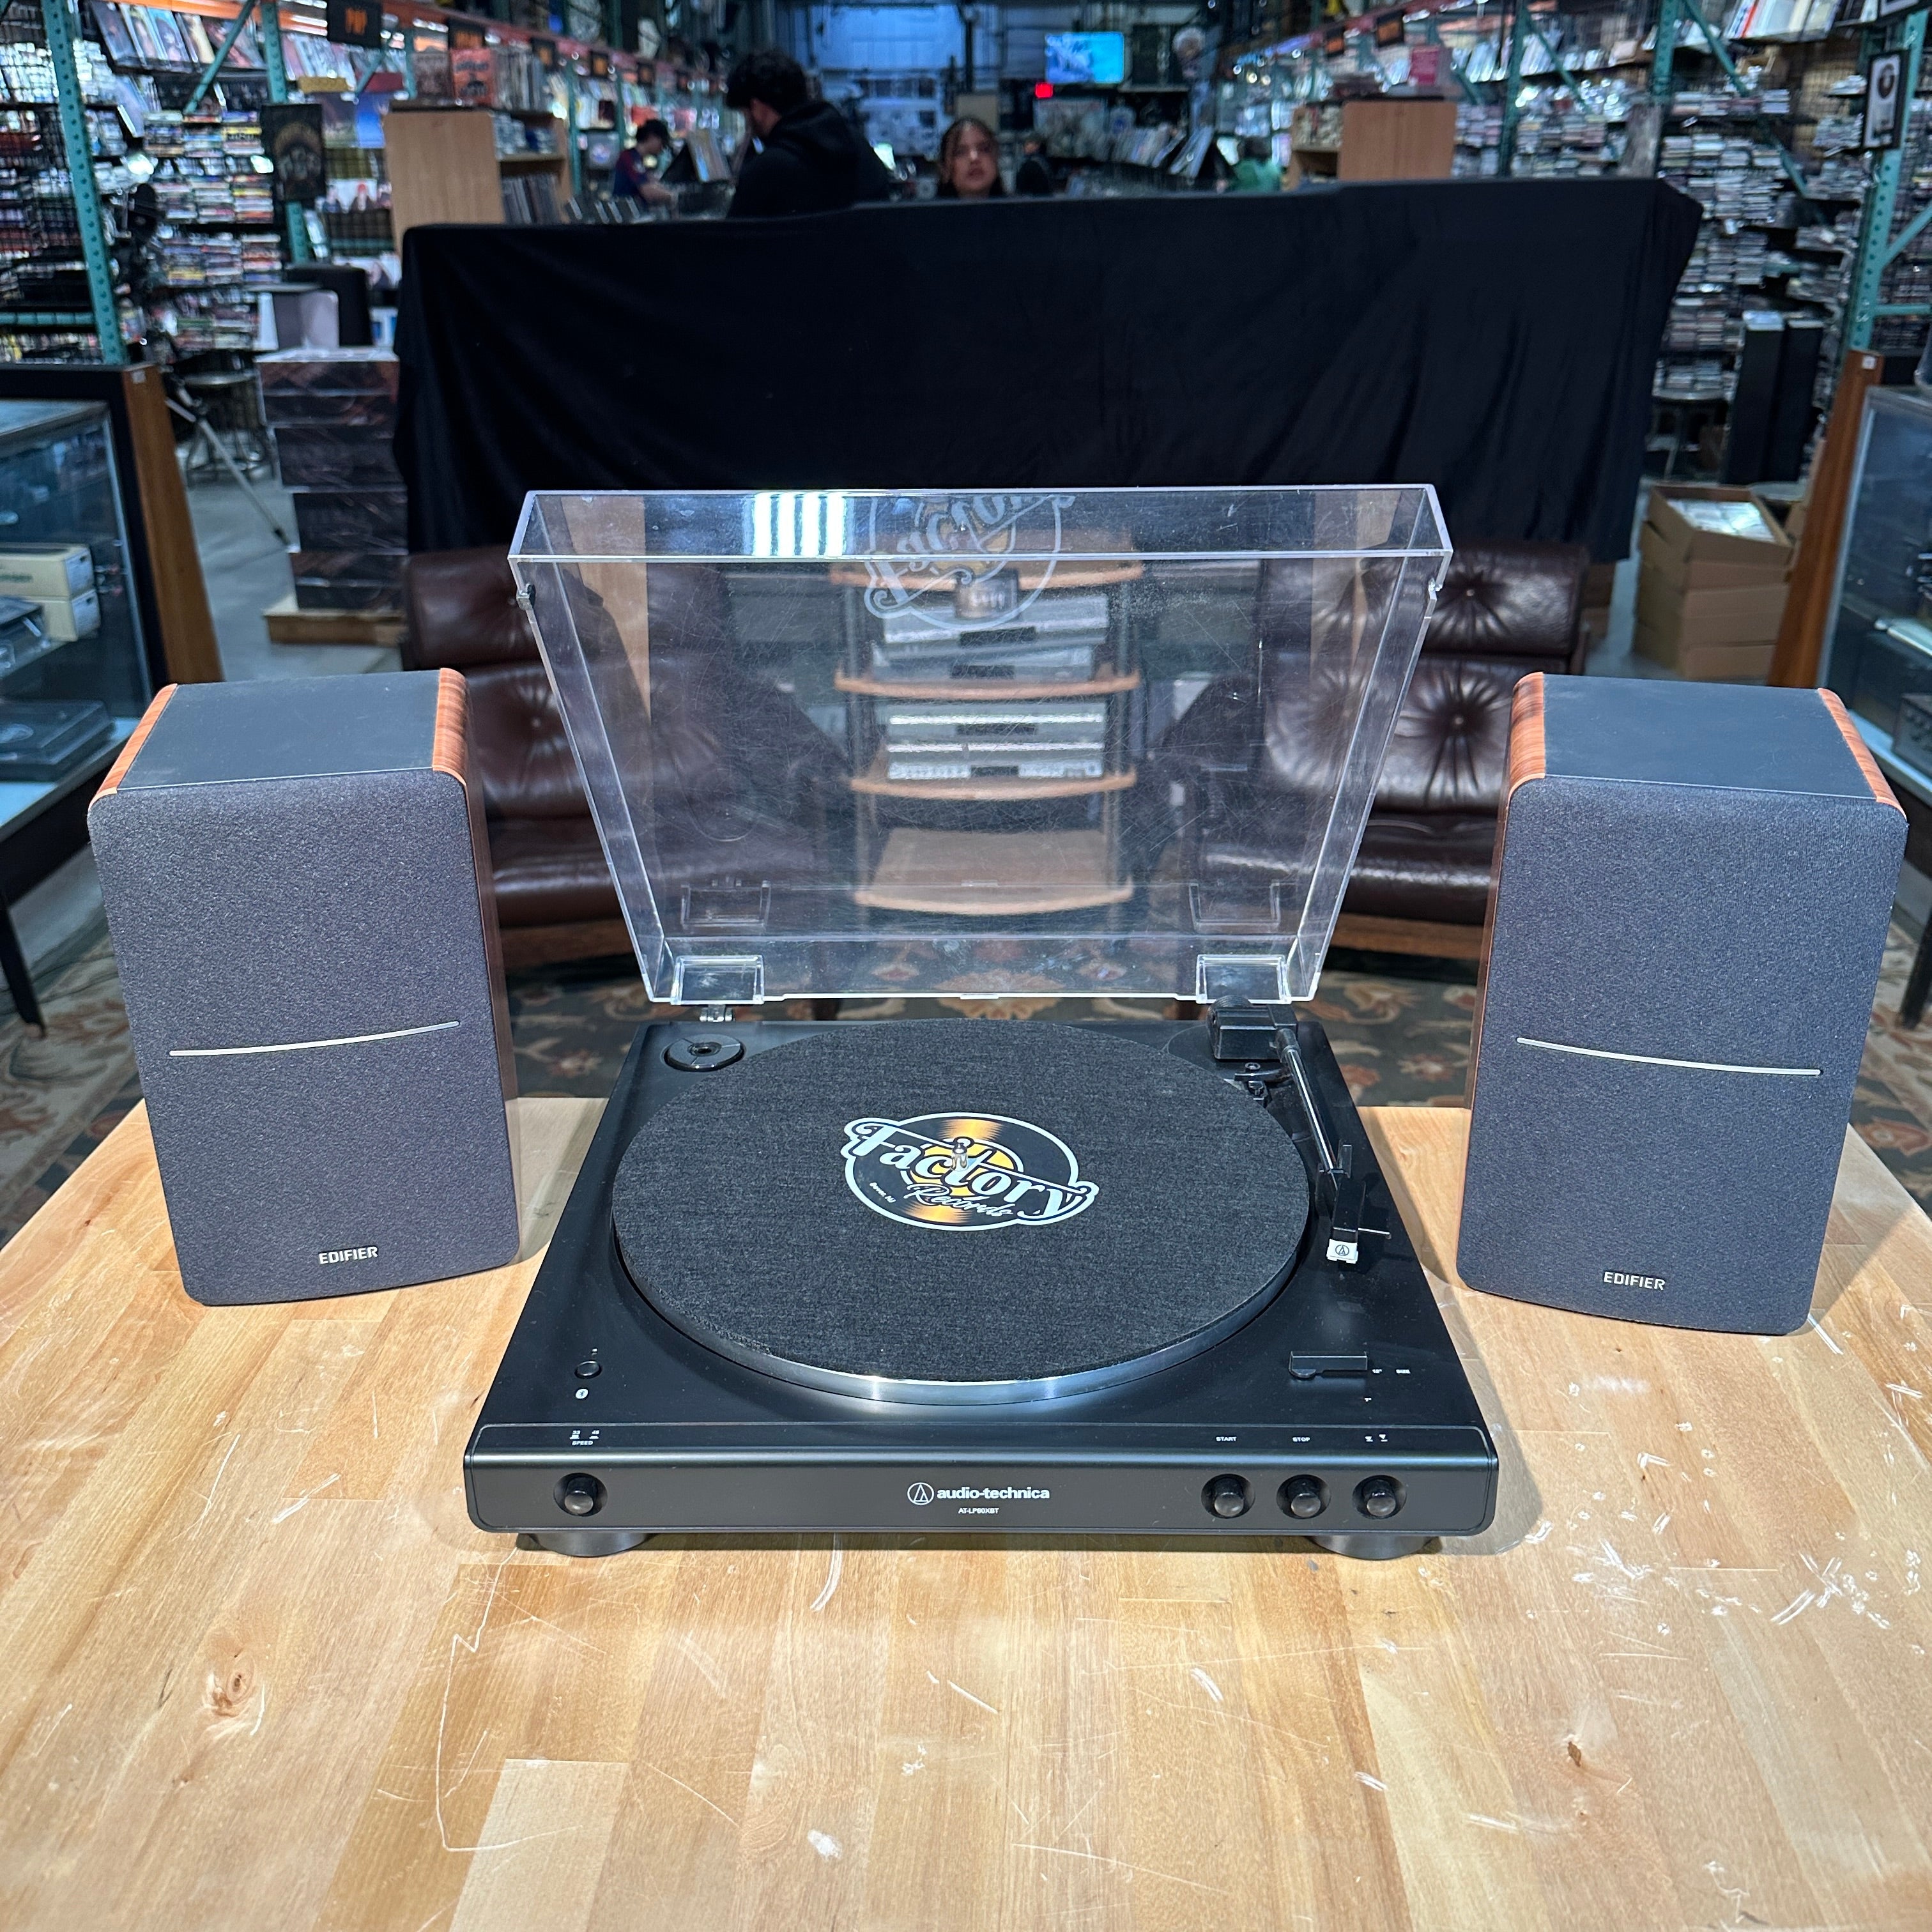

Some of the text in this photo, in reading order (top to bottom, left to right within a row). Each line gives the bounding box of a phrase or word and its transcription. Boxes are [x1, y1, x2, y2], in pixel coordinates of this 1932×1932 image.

[851, 1123, 1089, 1218] Factory
[903, 1183, 1016, 1217] Records
[319, 1246, 378, 1264] EDIFIER
[1604, 1271, 1666, 1291] EDIFIER
[937, 1486, 1050, 1499] audio-technica
